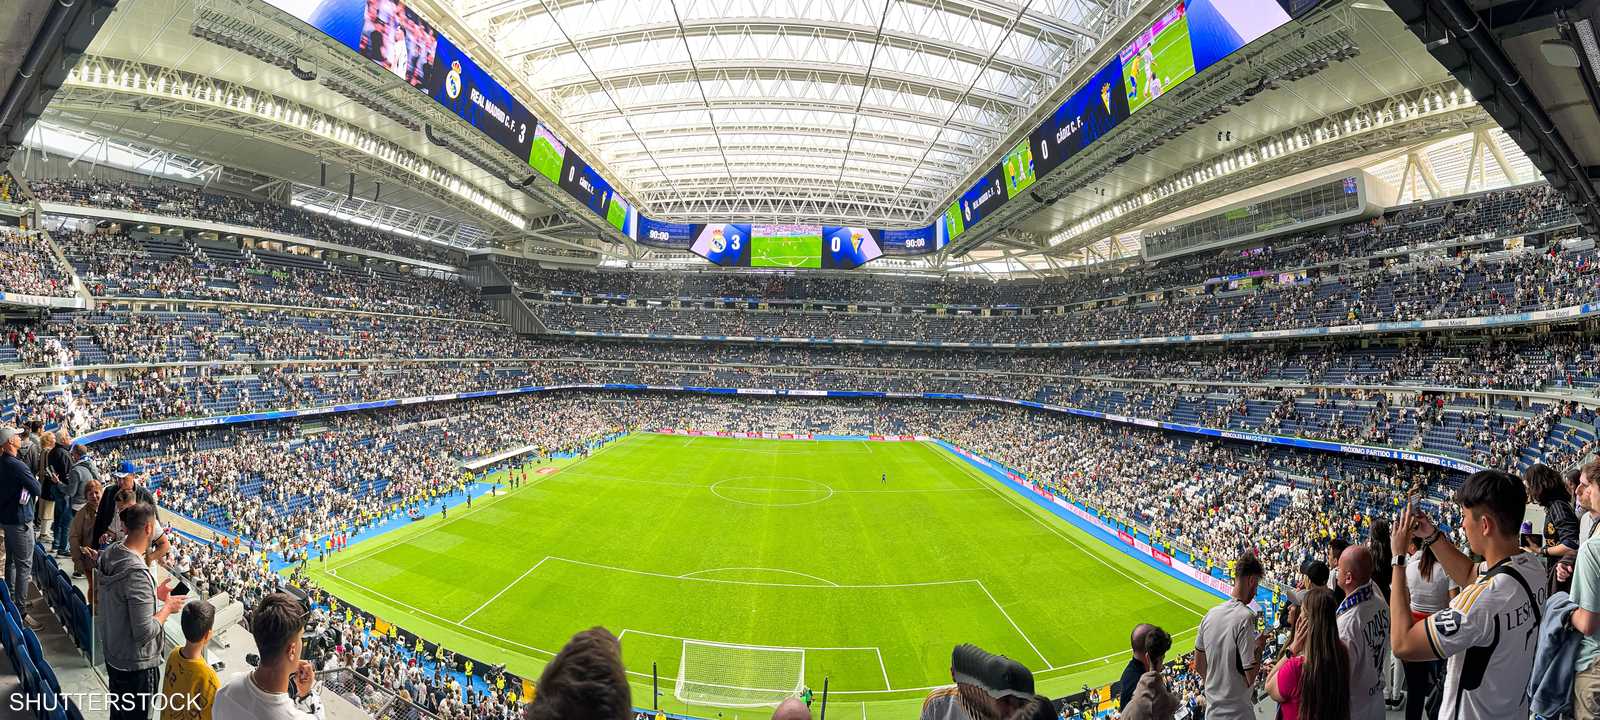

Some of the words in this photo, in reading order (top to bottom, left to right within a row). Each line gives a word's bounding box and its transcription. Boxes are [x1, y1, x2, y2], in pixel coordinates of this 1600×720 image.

[471, 87, 485, 109] REAL
[485, 98, 506, 123] MADRID
[518, 123, 527, 143] 3
[1041, 139, 1048, 159] 0
[568, 165, 575, 182] 0
[995, 178, 1001, 195] 3
[649, 229, 669, 241] 90:00
[731, 234, 741, 250] 3
[905, 237, 925, 248] 90:00
[831, 236, 841, 252] 0
[1365, 448, 1390, 458] PARTIDO
[1401, 452, 1417, 461] REAL
[1417, 454, 1440, 464] MADRID
